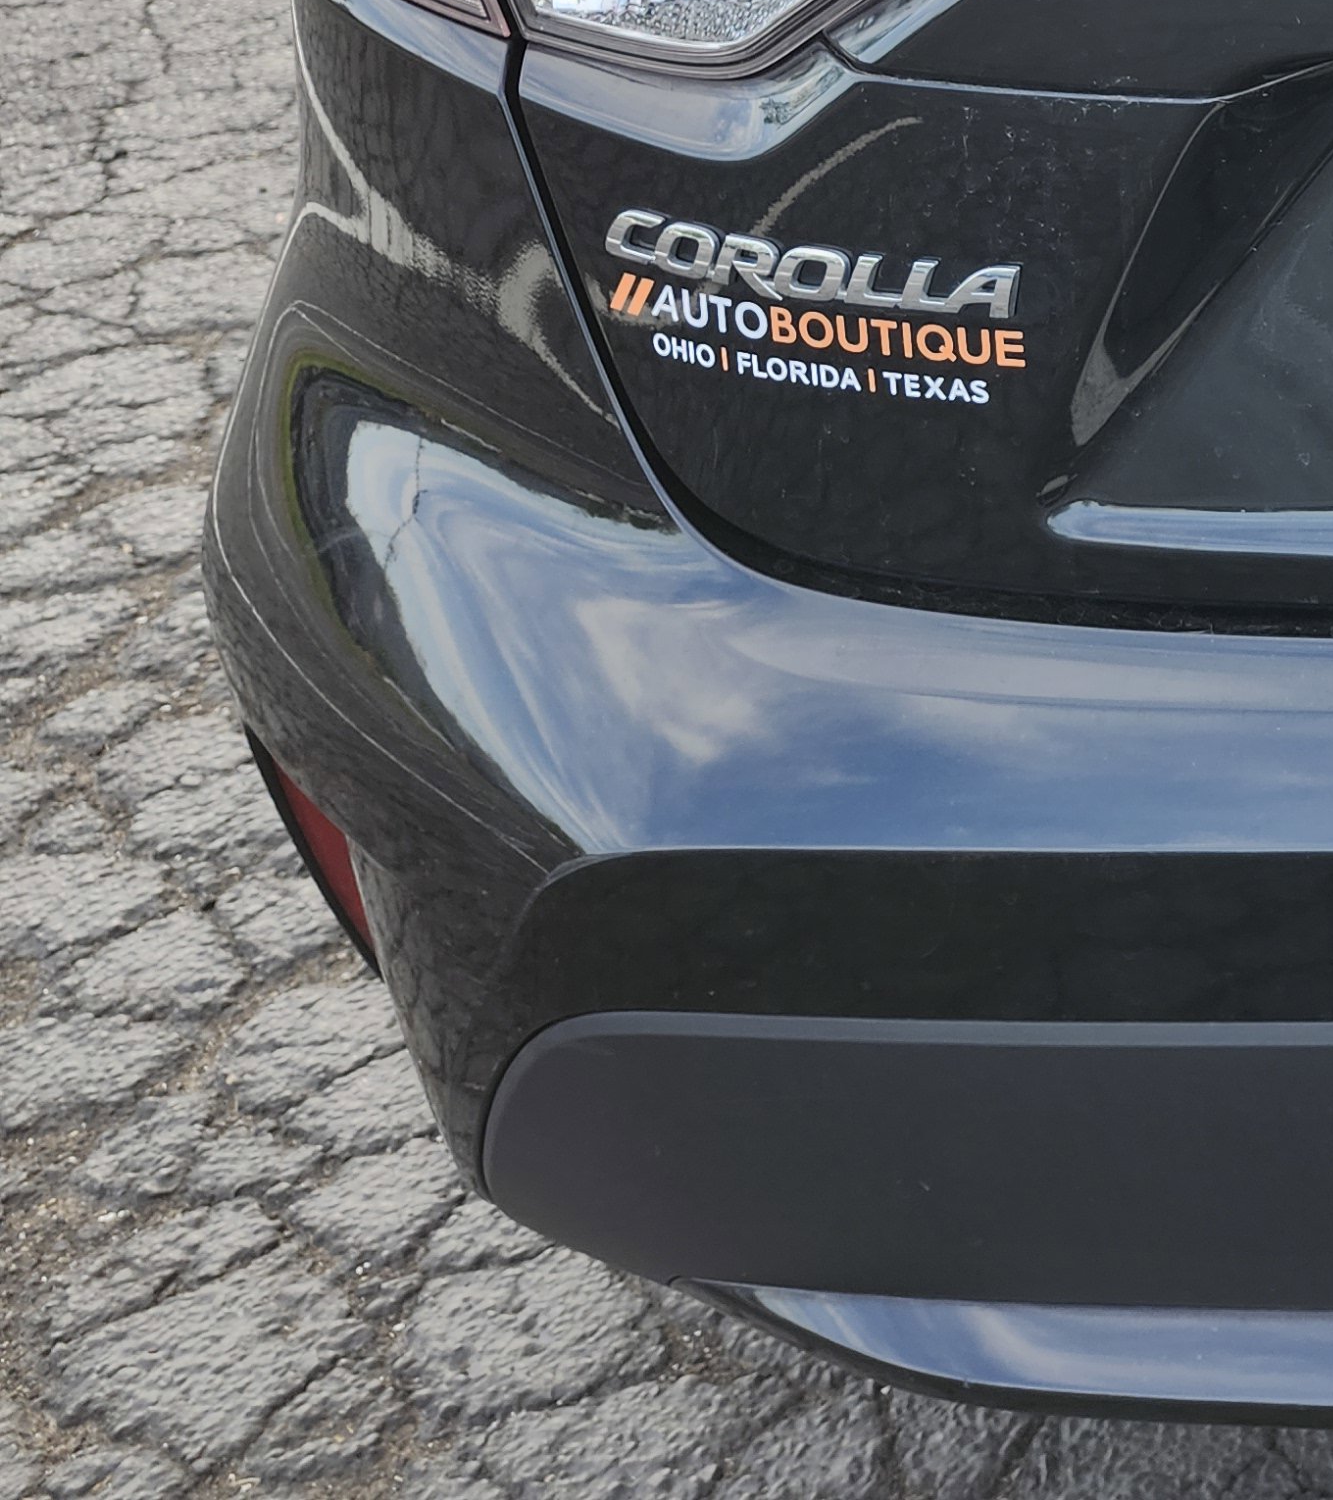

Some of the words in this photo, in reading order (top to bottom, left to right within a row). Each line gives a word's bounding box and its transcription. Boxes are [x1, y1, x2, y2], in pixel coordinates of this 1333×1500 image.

[604, 208, 1023, 319] COROLLA
[652, 331, 717, 369] OHIO
[736, 351, 862, 393] FLORIDA
[882, 370, 991, 405] TEXAS
